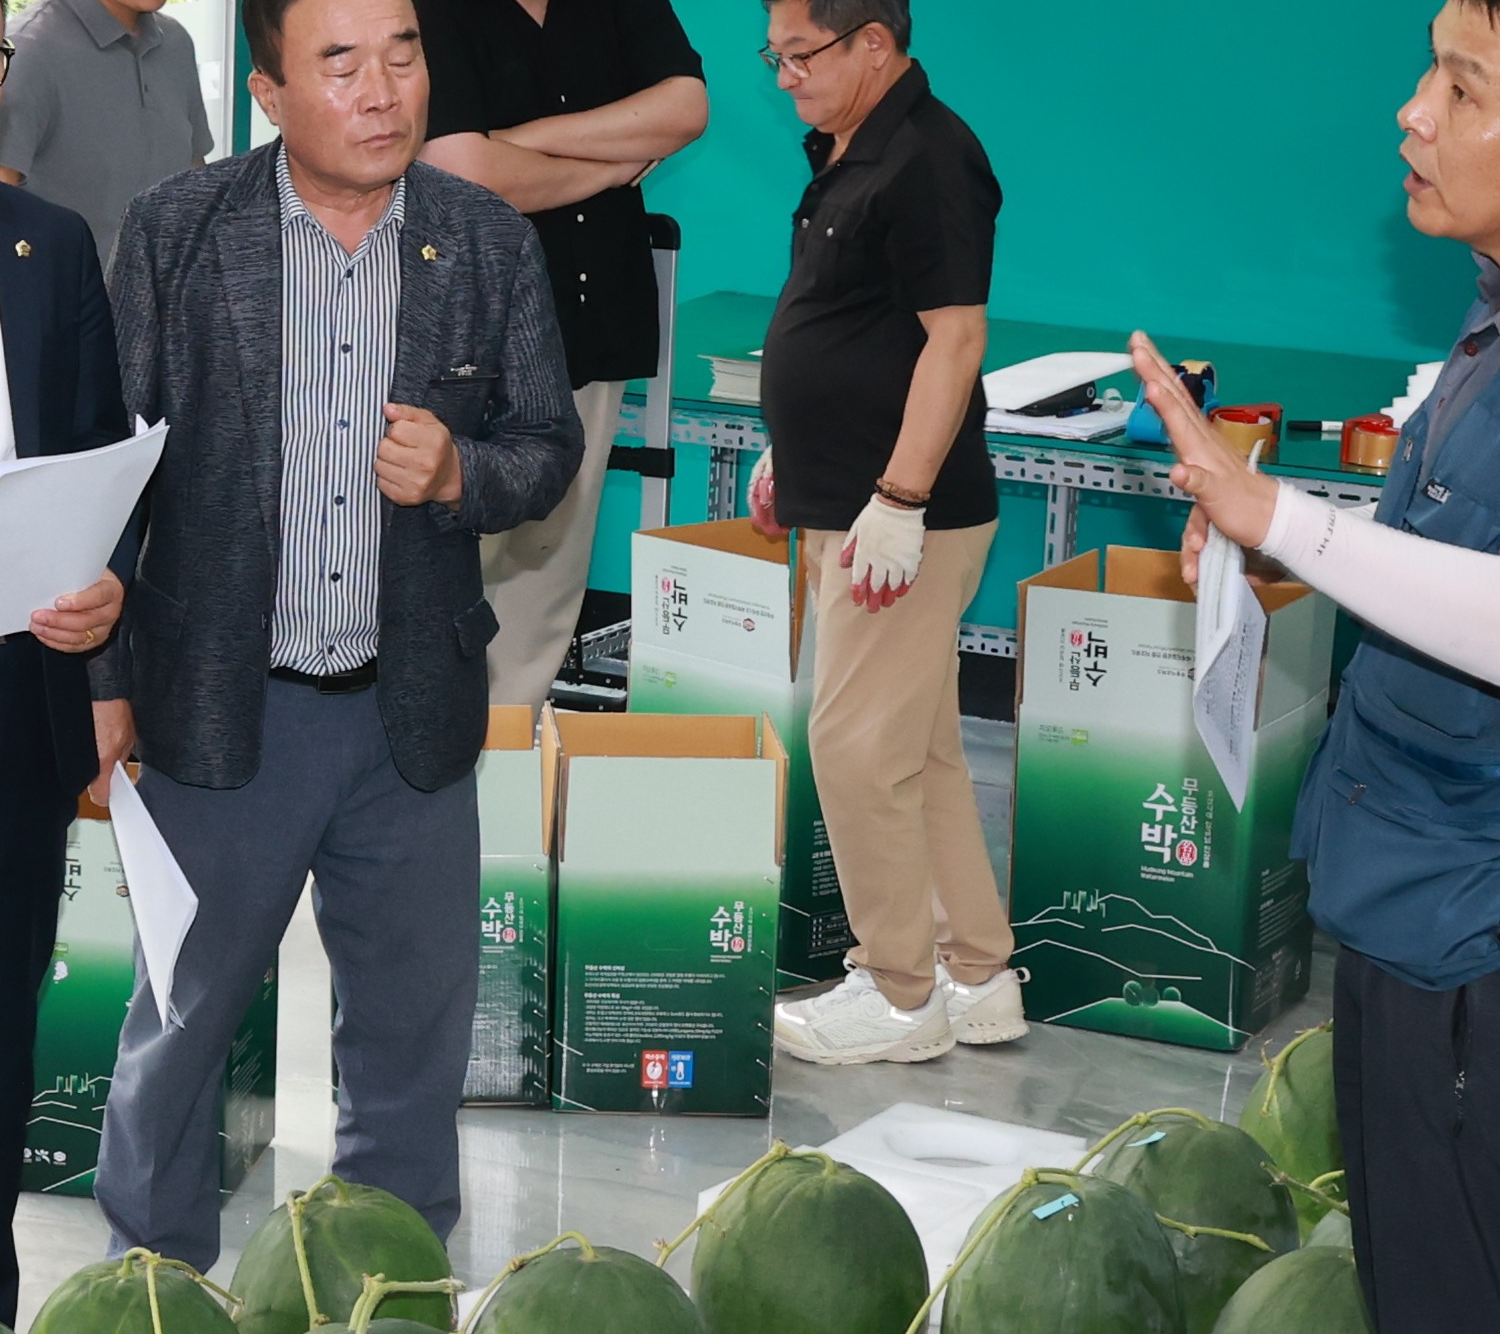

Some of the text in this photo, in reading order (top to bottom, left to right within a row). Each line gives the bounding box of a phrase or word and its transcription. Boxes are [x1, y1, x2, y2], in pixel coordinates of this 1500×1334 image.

[1141, 782, 1178, 864] 수박
[1180, 777, 1199, 835] 무등산
[481, 896, 503, 943] 수박
[710, 906, 732, 953] 수박
